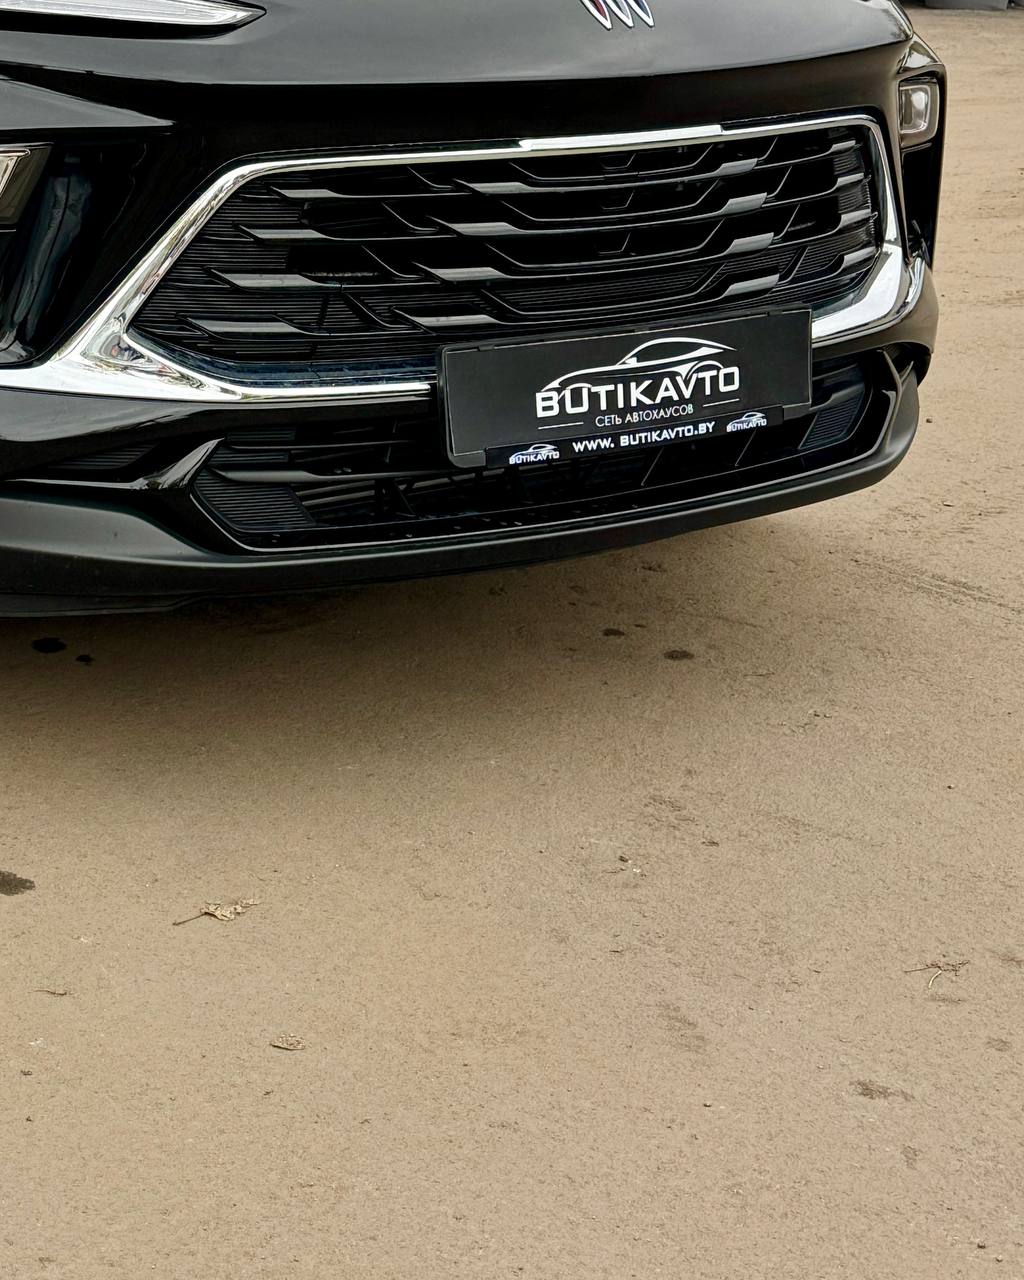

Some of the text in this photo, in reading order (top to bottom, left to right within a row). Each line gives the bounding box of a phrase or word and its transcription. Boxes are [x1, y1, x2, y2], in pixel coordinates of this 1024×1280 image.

[535, 366, 740, 418] BUTIKAVTO
[595, 404, 694, 428] СЕТЬ АВТОХАУСОВ
[572, 421, 716, 453] WWW. BUTIKAVTO.BY
[509, 451, 560, 465] BUTIKAVTO
